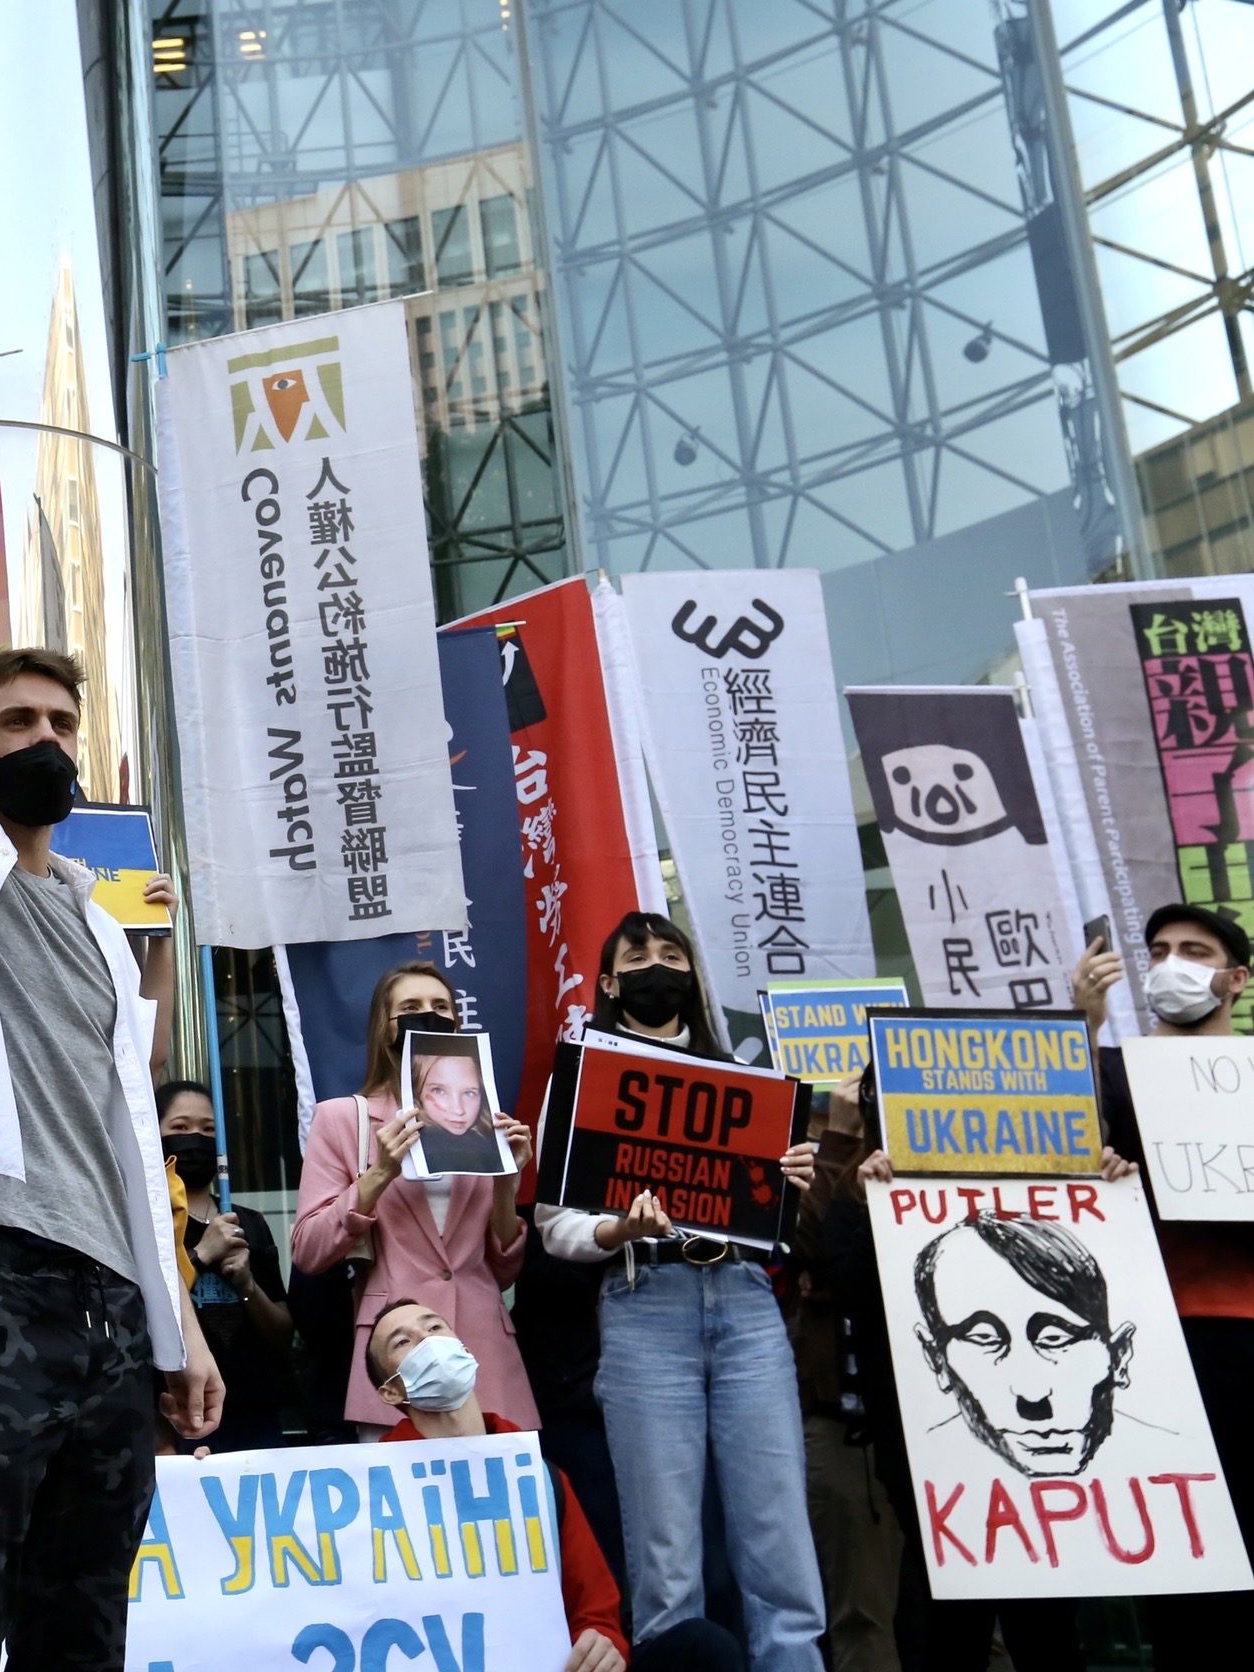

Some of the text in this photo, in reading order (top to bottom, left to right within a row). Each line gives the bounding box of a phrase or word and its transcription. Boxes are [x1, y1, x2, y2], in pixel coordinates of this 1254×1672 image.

[1052, 608, 1069, 639] The
[1143, 609, 1242, 657] 台灣
[1060, 640, 1096, 739] Association
[1086, 742, 1105, 762] of
[1090, 764, 1115, 825] Parent
[701, 667, 752, 979] Economic Democracy Union
[722, 666, 810, 976] 經濟民主連合
[776, 1003, 847, 1029] STAND
[783, 1041, 871, 1075] UKRA
[884, 1027, 1088, 1072] HONGKONG
[922, 1069, 1047, 1092] STANDS WITH
[1189, 1056, 1241, 1094] NO
[614, 1069, 754, 1148] STOP
[905, 1108, 1091, 1157] UKRAINE
[615, 1142, 732, 1191] RUSSIAN
[889, 1183, 1107, 1226] PUTLER
[923, 1472, 1218, 1569] KAPUT
